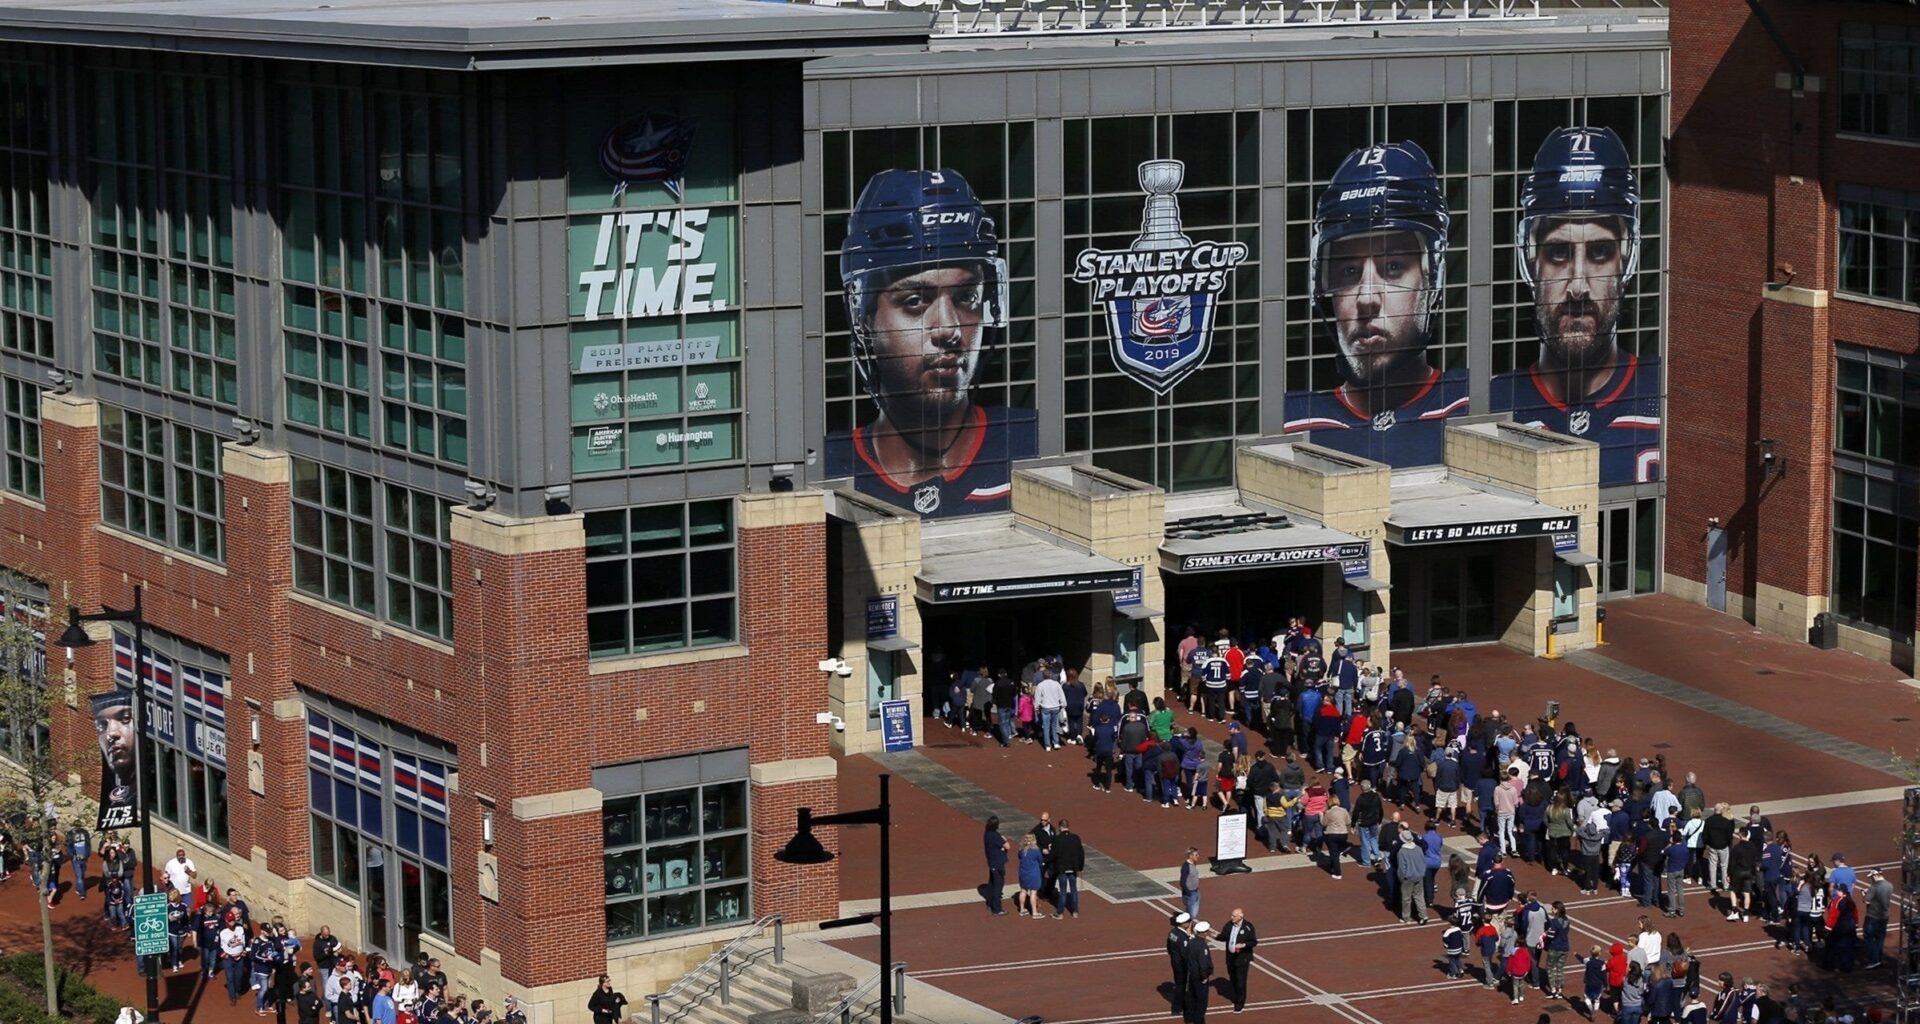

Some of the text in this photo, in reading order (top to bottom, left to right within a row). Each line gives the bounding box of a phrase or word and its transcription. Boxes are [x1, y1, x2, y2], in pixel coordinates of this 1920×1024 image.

[1571, 134, 1591, 151] 71
[1357, 148, 1386, 167] 13
[921, 212, 971, 226] CCM
[593, 209, 710, 266] IT'S
[1078, 245, 1245, 279] STANLEY CUP
[578, 262, 727, 321] TIME.
[1097, 270, 1224, 299] PLAYOFFS
[590, 340, 713, 358] 2019 PLAYOFFS
[1144, 348, 1180, 361] 2019
[595, 351, 706, 368] PRESENTED BY
[688, 398, 717, 407] VECTOR
[1411, 527, 1444, 541] LET'S
[1466, 523, 1518, 537] JACKETS
[1541, 519, 1572, 532] #CBJ
[1187, 555, 1239, 568] STANLEY
[1238, 552, 1264, 564] CUP
[1263, 549, 1322, 563] PLAYOFFS
[952, 585, 970, 597] IT'S
[1210, 667, 1222, 679] 71
[146, 701, 174, 737] STORE
[1373, 738, 1382, 752] 3
[1538, 756, 1549, 770] 13
[105, 805, 132, 819] IT'S
[1812, 896, 1824, 911] 13
[1460, 911, 1473, 926] 72
[151, 931, 166, 939] ROUTE
